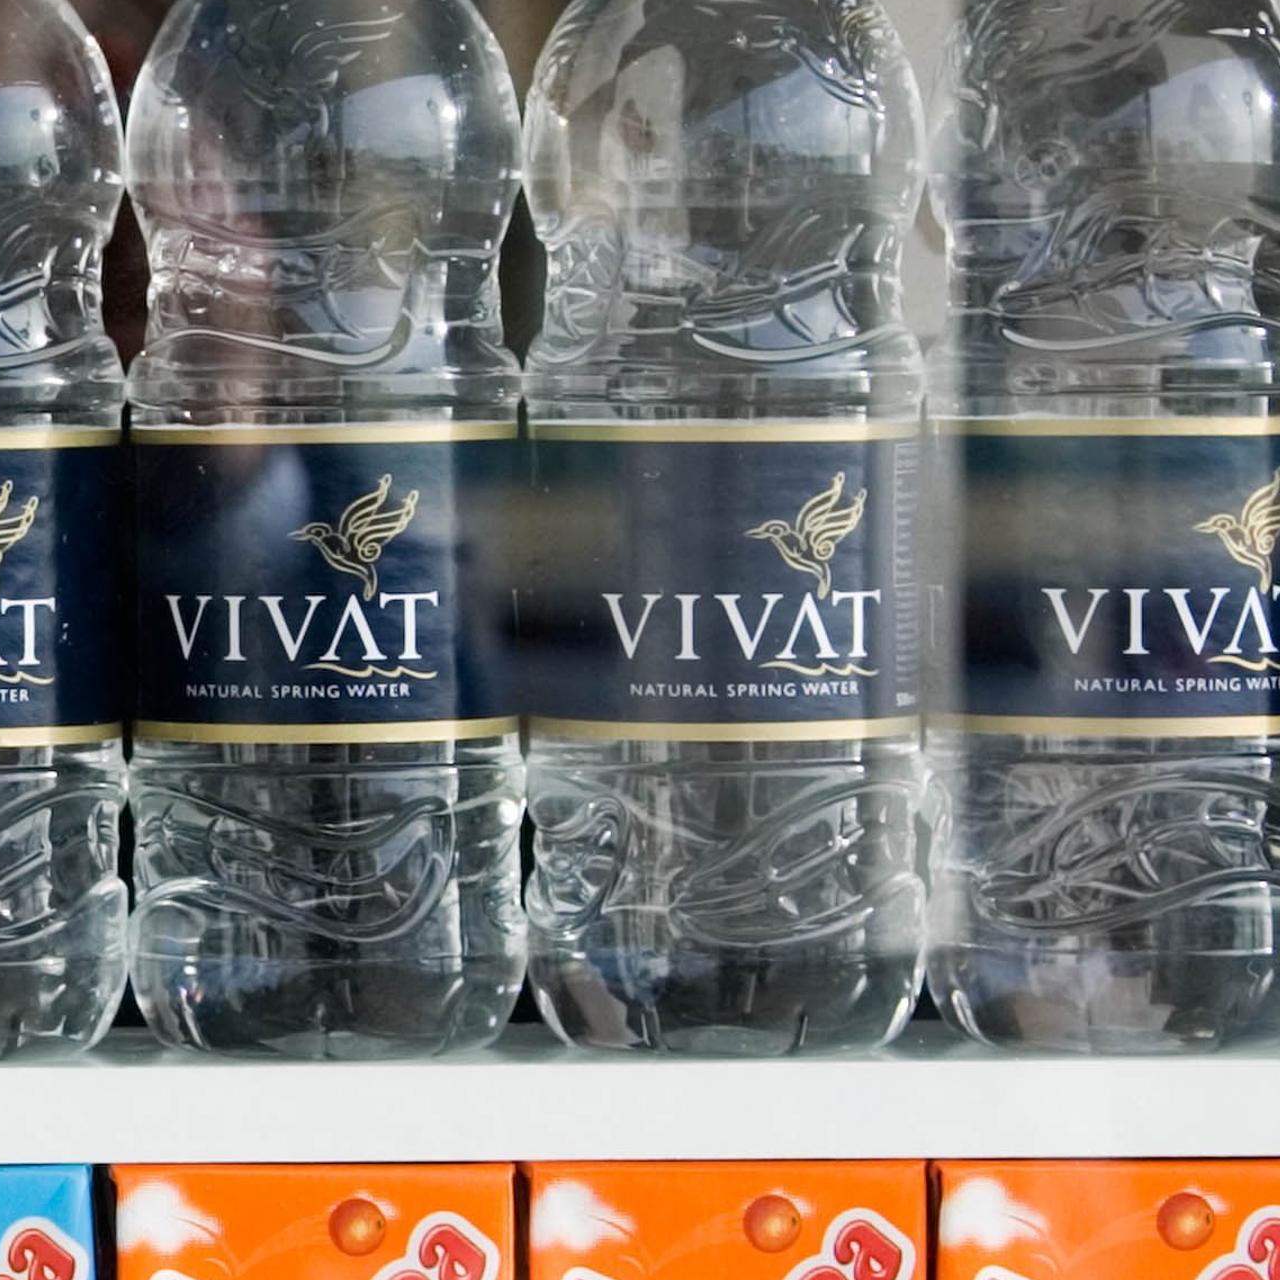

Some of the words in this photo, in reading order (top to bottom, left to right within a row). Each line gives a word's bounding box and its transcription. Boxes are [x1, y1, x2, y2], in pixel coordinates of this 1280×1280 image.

[165, 590, 439, 663] VIVAT
[603, 589, 881, 661] VIVAT
[630, 681, 718, 698] NATURAL
[726, 680, 797, 700] SPRING
[802, 679, 860, 697] WATER
